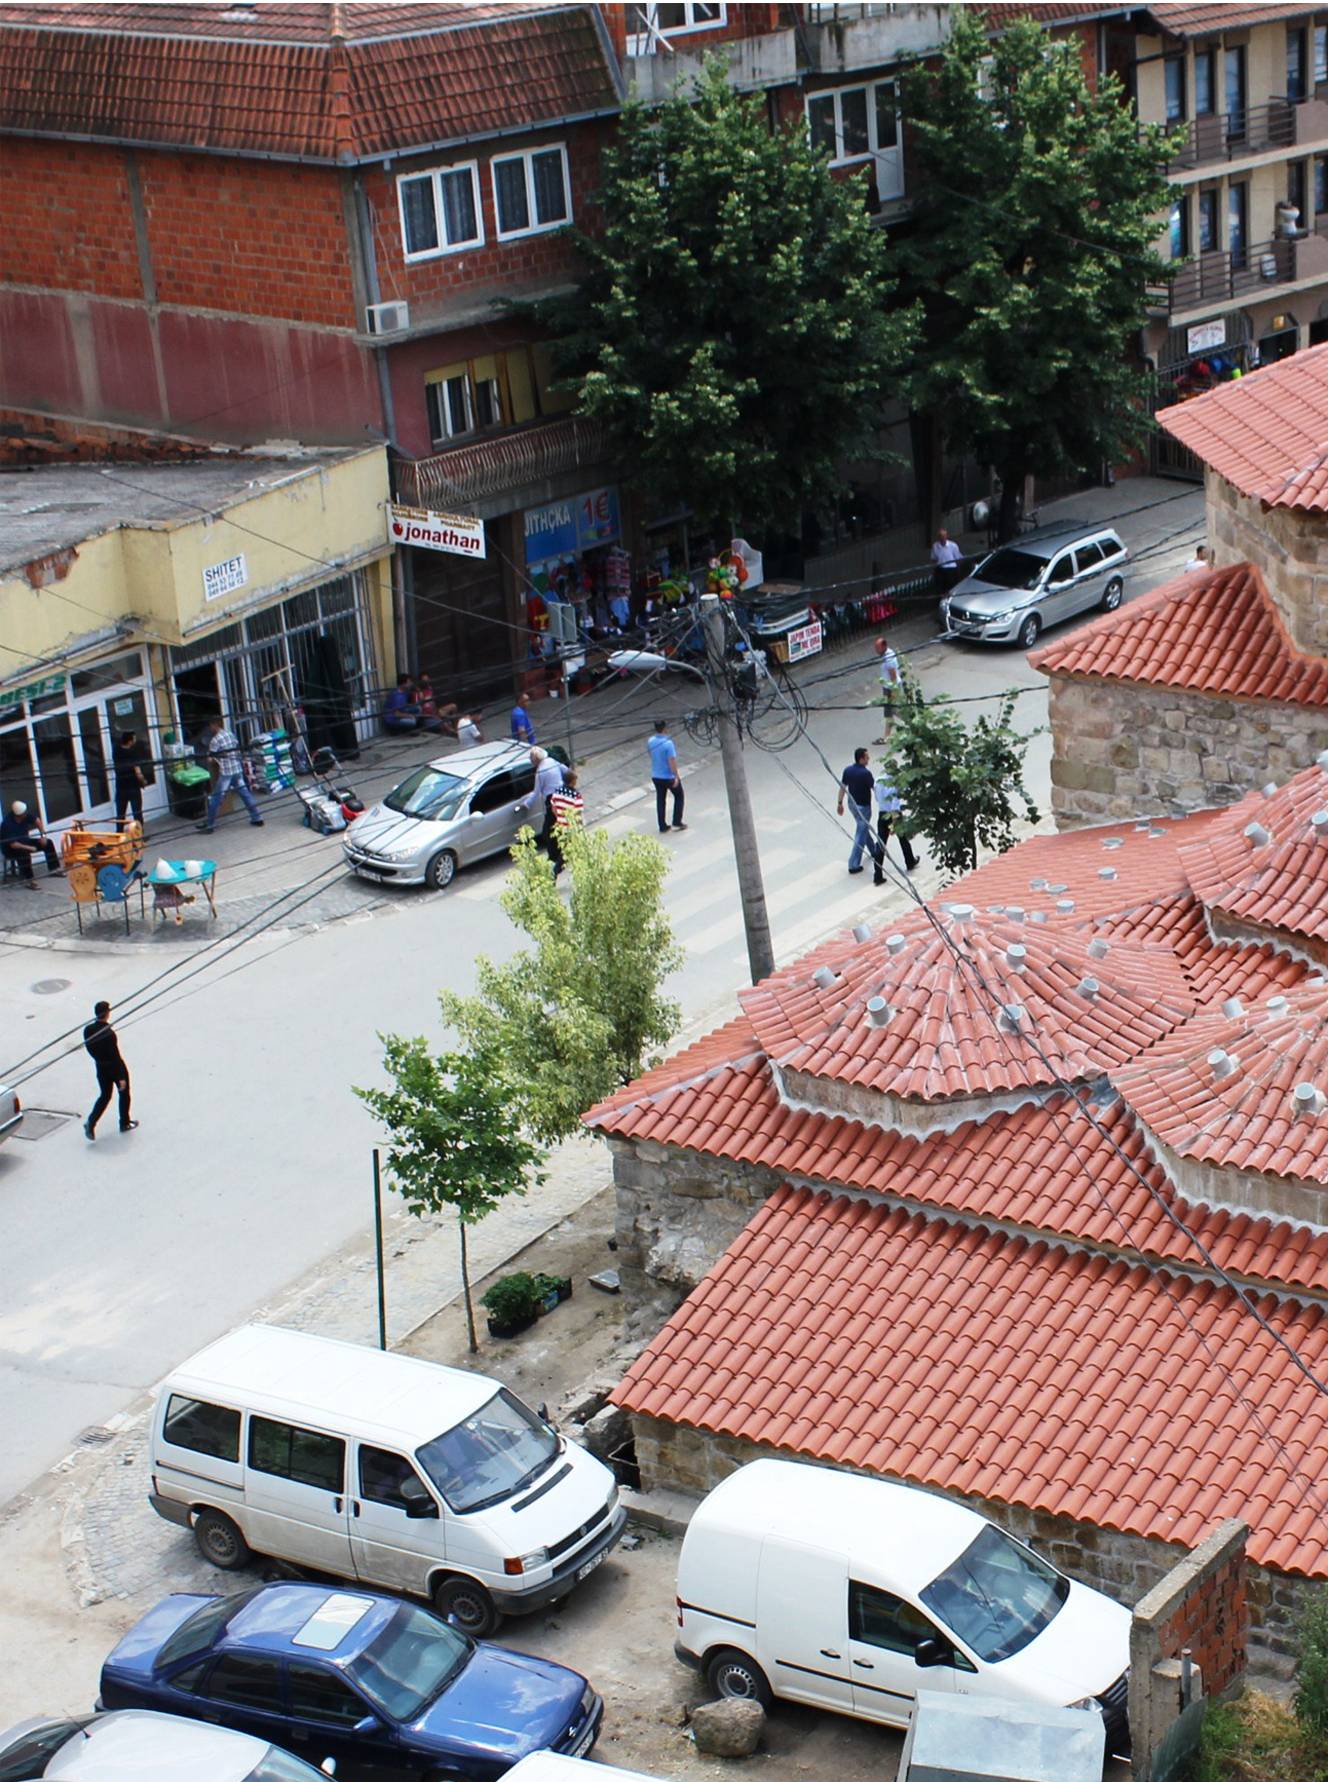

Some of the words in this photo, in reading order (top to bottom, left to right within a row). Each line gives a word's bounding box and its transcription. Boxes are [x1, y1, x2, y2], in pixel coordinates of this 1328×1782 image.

[583, 491, 609, 527] 1€
[404, 521, 480, 550] jonathan
[205, 556, 242, 583] SHITET
